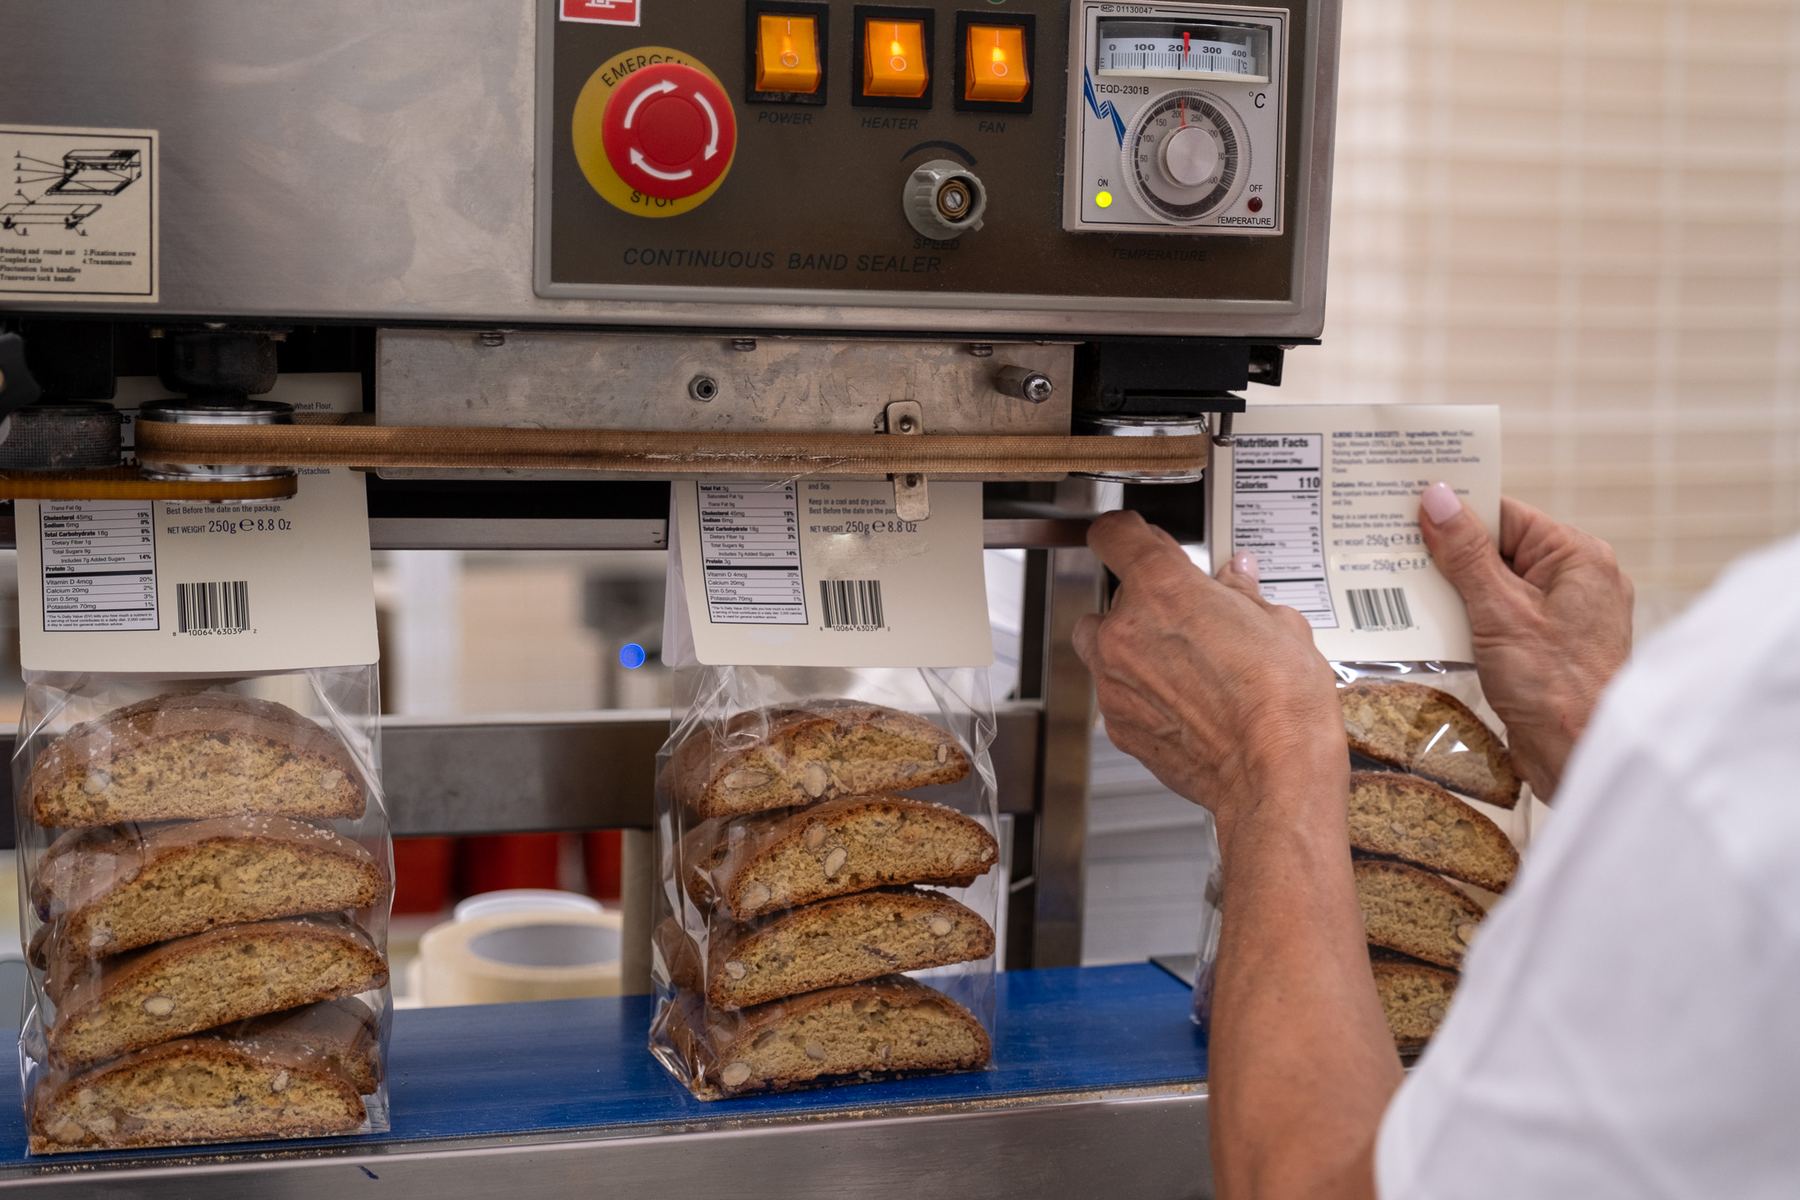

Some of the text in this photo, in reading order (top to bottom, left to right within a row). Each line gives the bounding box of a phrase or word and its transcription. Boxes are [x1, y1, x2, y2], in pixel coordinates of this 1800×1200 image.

[1116, 5, 1152, 14] 01130047
[1134, 43, 1155, 51] 100
[1202, 46, 1221, 54] 300
[1095, 84, 1149, 95] TEQD-2301B
[758, 111, 812, 124] POWER
[1156, 119, 1167, 127] 150
[1191, 114, 1202, 122] 250
[861, 117, 919, 130] HEATER
[978, 120, 1005, 133] FAN
[1098, 179, 1108, 187] ON
[1217, 217, 1271, 225] TEMPERATURE
[913, 238, 960, 249] SPEED
[1112, 248, 1207, 260] TEMPERATURE
[623, 248, 941, 272] CONTINUOUS BAND SEALER
[1235, 437, 1309, 448] Nutrition Facts
[298, 468, 330, 476] Pistachios
[1235, 477, 1320, 489] Calories 110
[809, 498, 822, 506] Keep
[860, 498, 870, 506] dry
[166, 506, 181, 515] Best
[182, 506, 203, 515] Before
[204, 505, 215, 514] the
[216, 505, 231, 513] date
[242, 504, 252, 513] the
[167, 526, 180, 535] NET
[181, 525, 206, 534] WEIGHT
[208, 520, 236, 535] 250g
[257, 519, 275, 531] 8.8
[810, 525, 821, 533] NET
[822, 525, 844, 533] WEIGHT
[845, 520, 870, 535] 250g
[888, 521, 902, 533] 8.8
[59, 530, 95, 539] Carbohydrate
[1366, 533, 1389, 547] 250g
[66, 548, 84, 556] Sugars
[1372, 559, 1396, 573] 250g
[72, 587, 90, 595] 20mg
[79, 603, 97, 611] 70mg
